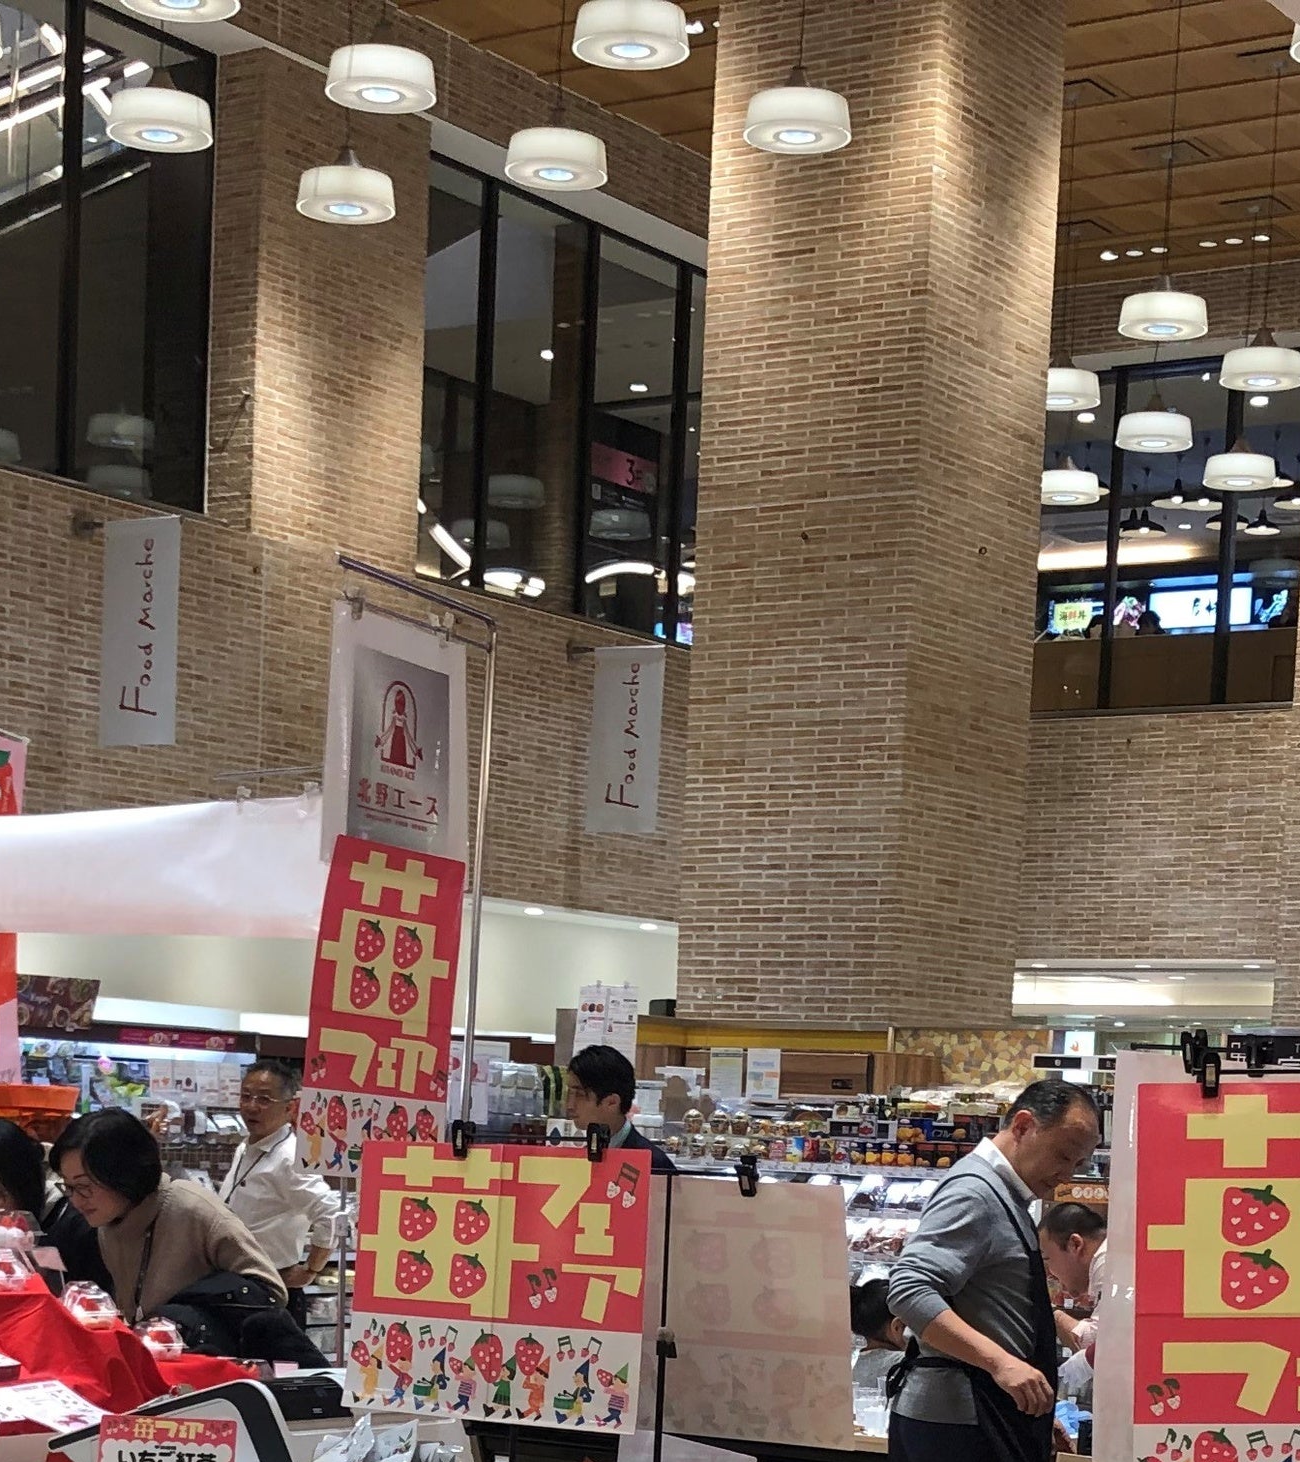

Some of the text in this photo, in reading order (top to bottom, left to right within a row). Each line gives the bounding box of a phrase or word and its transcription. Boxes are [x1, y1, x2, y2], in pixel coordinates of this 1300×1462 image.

[119, 537, 158, 716] Food Marche
[357, 778, 439, 816] 北野エース
[606, 746, 640, 809] Food
